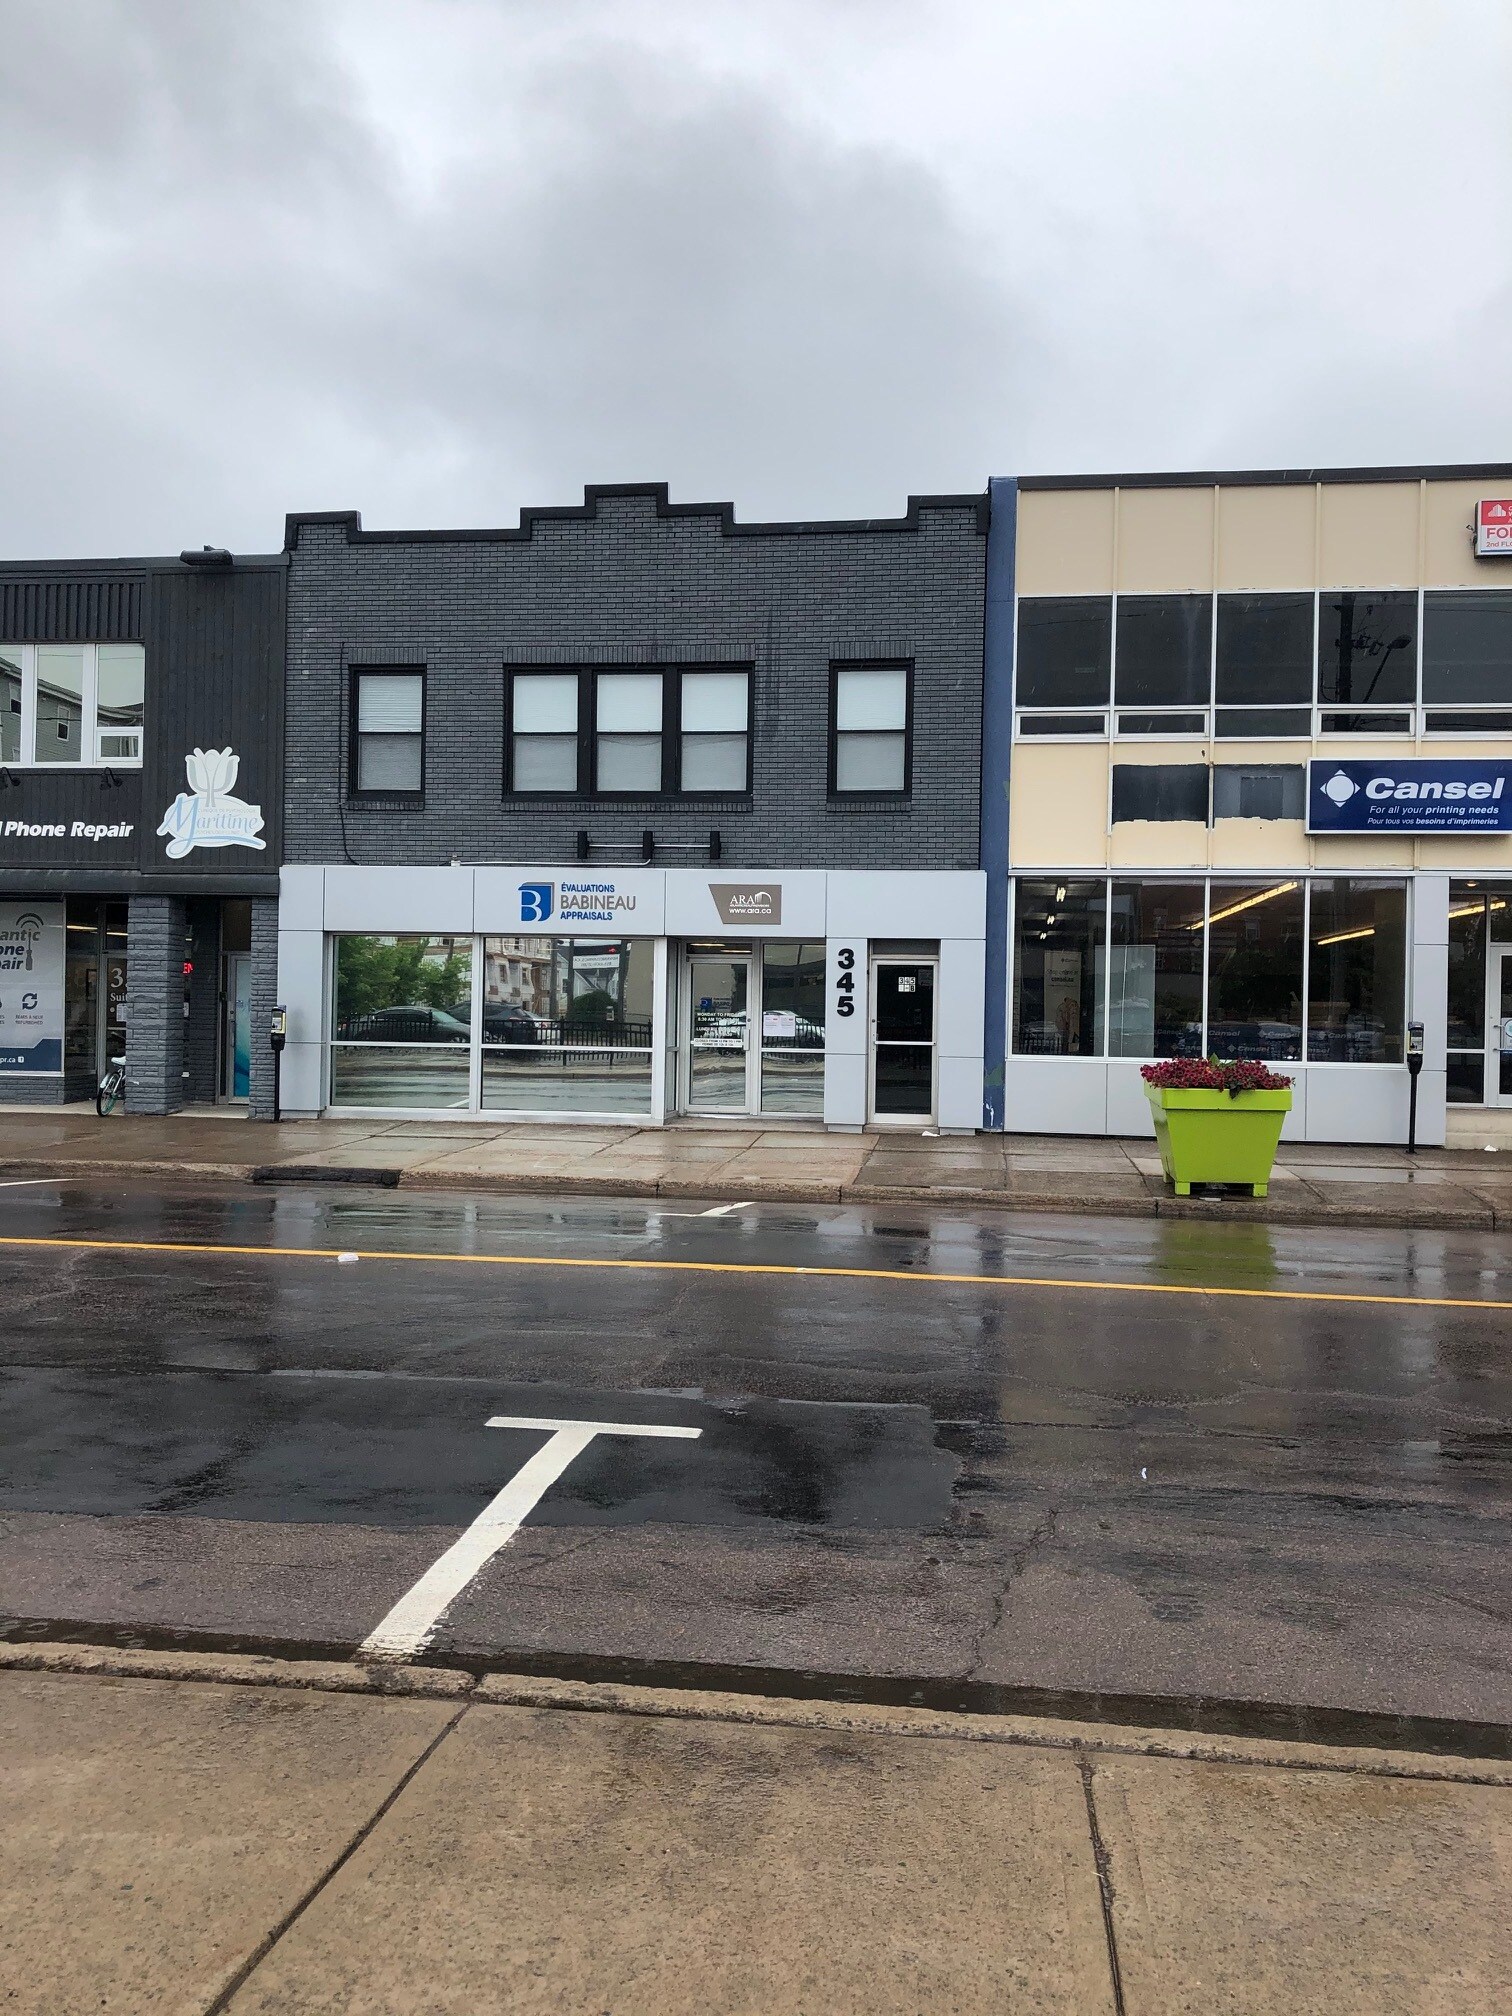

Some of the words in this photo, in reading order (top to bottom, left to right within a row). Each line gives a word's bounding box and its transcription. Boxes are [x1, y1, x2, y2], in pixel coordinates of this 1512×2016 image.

[1486, 527, 1512, 539] FO
[1365, 777, 1505, 799] Cansel
[1369, 805, 1386, 813] For
[1388, 805, 1399, 814] all
[1402, 807, 1423, 815] your
[1425, 805, 1465, 816] printing
[1468, 806, 1499, 814] needs
[1367, 817, 1384, 825] Pour
[1447, 818, 1499, 826] d'imprimeries
[4, 821, 66, 837] Phone
[70, 821, 134, 841] Repair
[561, 881, 615, 893] ÉVALUATIONS
[560, 894, 636, 911] BABINEAU
[730, 894, 755, 904] ARA
[560, 911, 613, 921] APPRAISALS
[0, 957, 24, 970] air
[110, 967, 128, 988] 3
[836, 948, 855, 1017] 345
